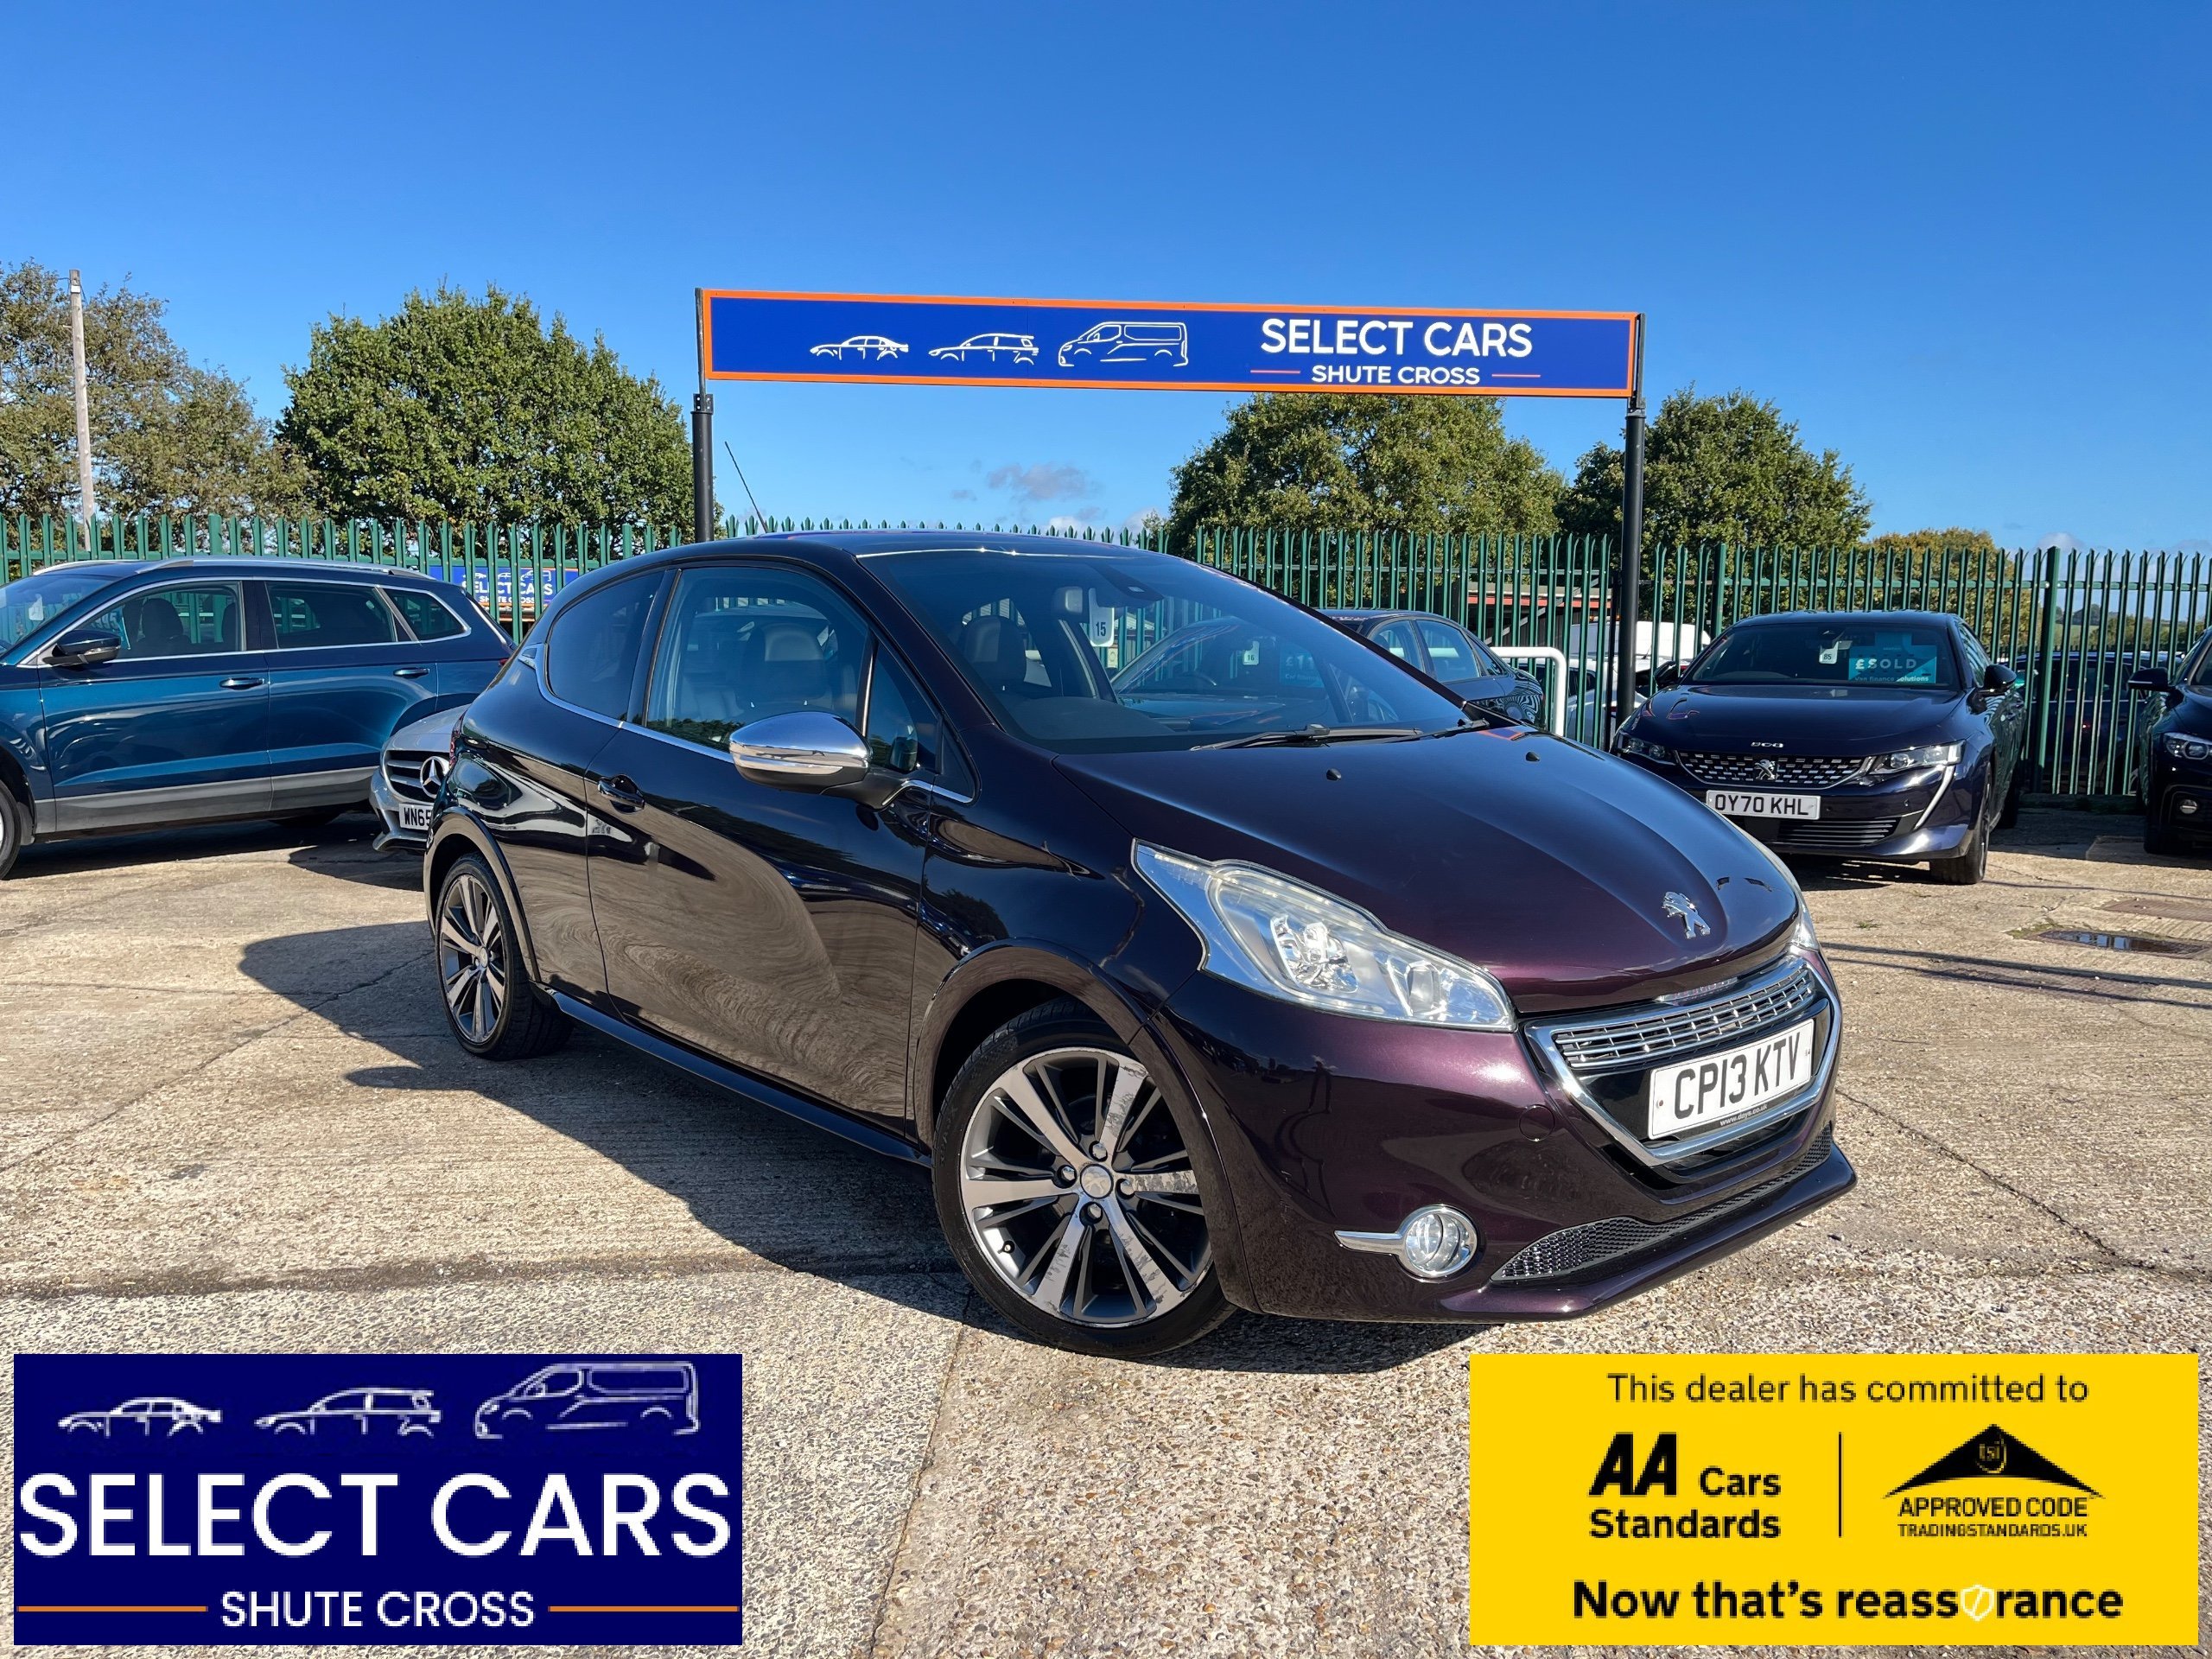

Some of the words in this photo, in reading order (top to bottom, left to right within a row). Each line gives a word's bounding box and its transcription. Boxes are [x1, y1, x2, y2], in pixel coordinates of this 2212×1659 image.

[1261, 318, 1414, 355] SELECT
[1424, 321, 1533, 358] CARS
[1311, 365, 1392, 384] SHUTE
[1397, 366, 1480, 385] CROSS
[462, 581, 512, 594] ELCT
[519, 582, 553, 595] CAS
[478, 595, 507, 604] SHTE
[1096, 621, 1106, 636] 15
[1714, 793, 1764, 813] OY70
[1770, 797, 1809, 816] KHL
[1674, 1053, 1747, 1120] CP13
[1754, 1032, 1801, 1096] KTV
[1719, 1103, 1768, 1126] www.days.co.uk
